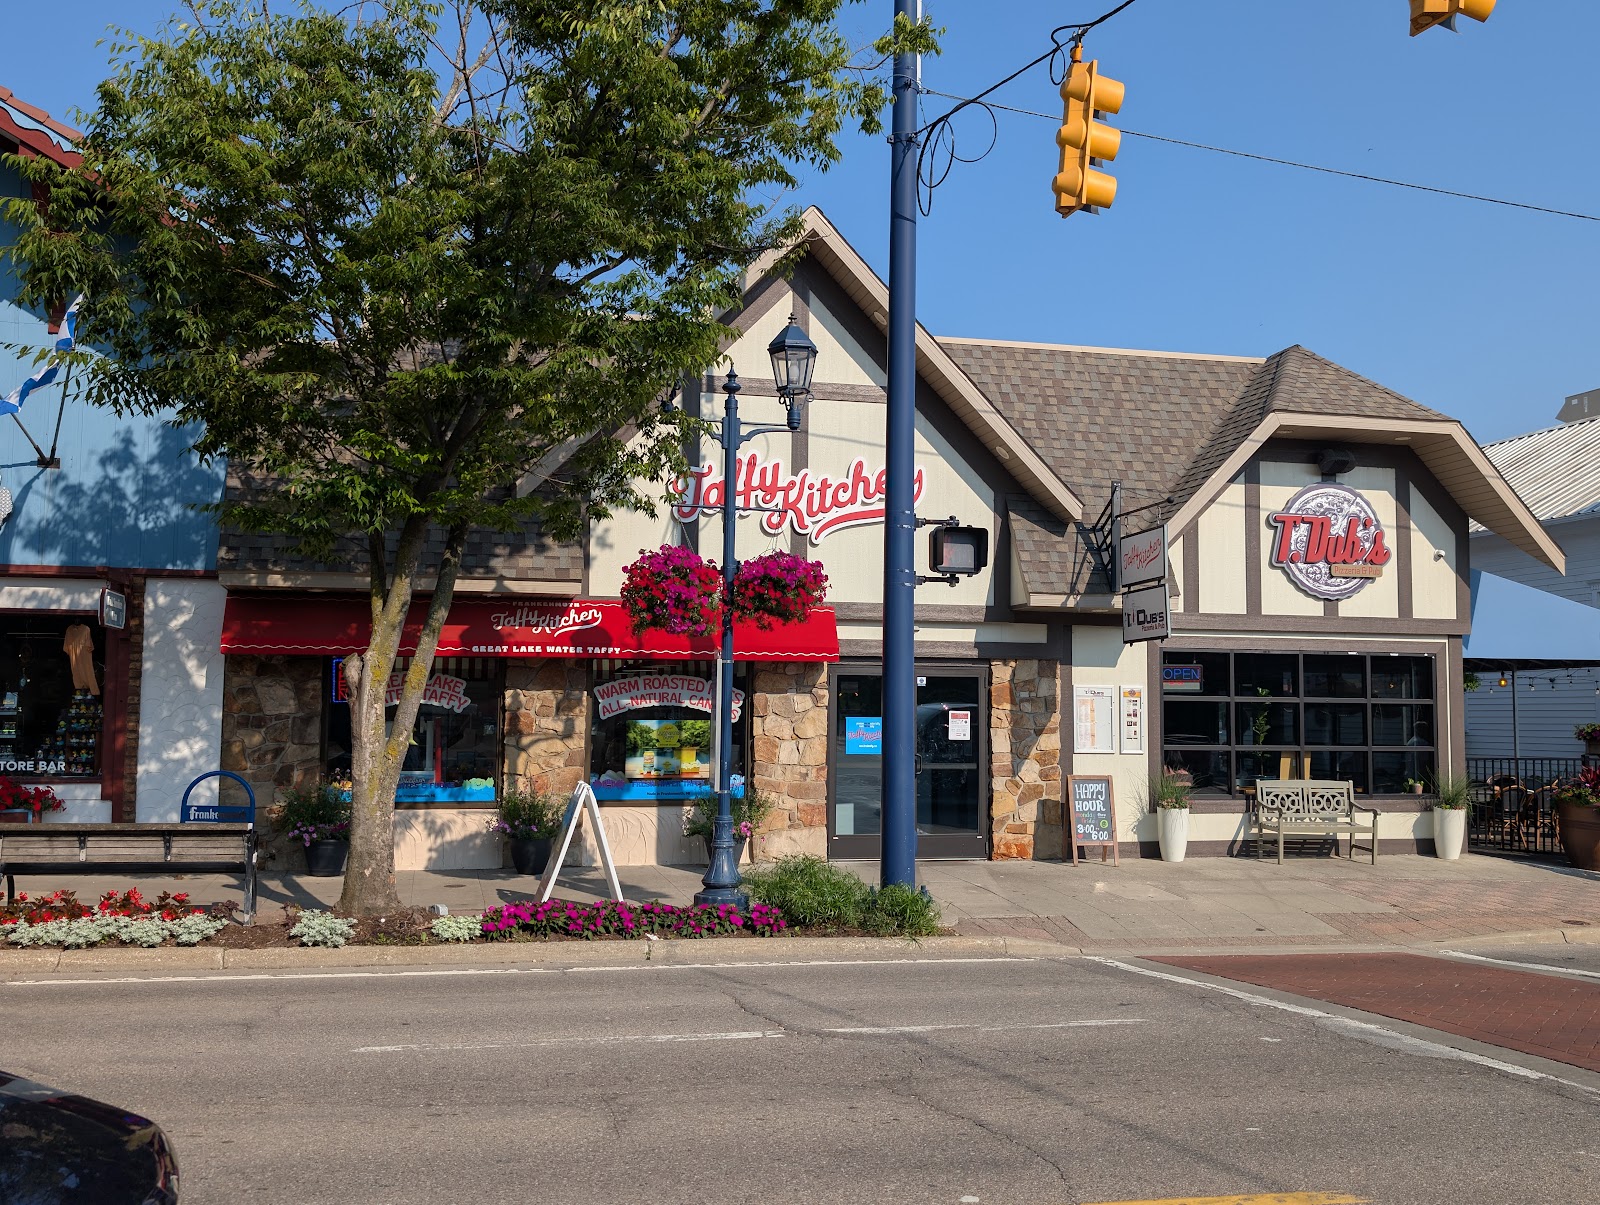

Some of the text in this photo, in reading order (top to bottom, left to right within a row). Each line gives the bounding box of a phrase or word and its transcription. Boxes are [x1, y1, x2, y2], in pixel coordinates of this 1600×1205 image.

[672, 453, 923, 538] Taffy Kitche
[1123, 538, 1162, 570] Taffy Kitchen
[1334, 565, 1381, 576] Pizzeria & Pub
[491, 607, 602, 637] Taffy Kitchen
[472, 645, 621, 655] GREAT LAKE WATER TAFFY
[1163, 668, 1200, 680] OPEN
[597, 677, 705, 701] WARM ROASTED
[602, 692, 685, 717] ALL-NATURAL
[39, 761, 66, 771] BAR
[1075, 783, 1105, 801] HAPPY
[1075, 800, 1106, 812] HOUR
[1077, 824, 1095, 834] 3:00
